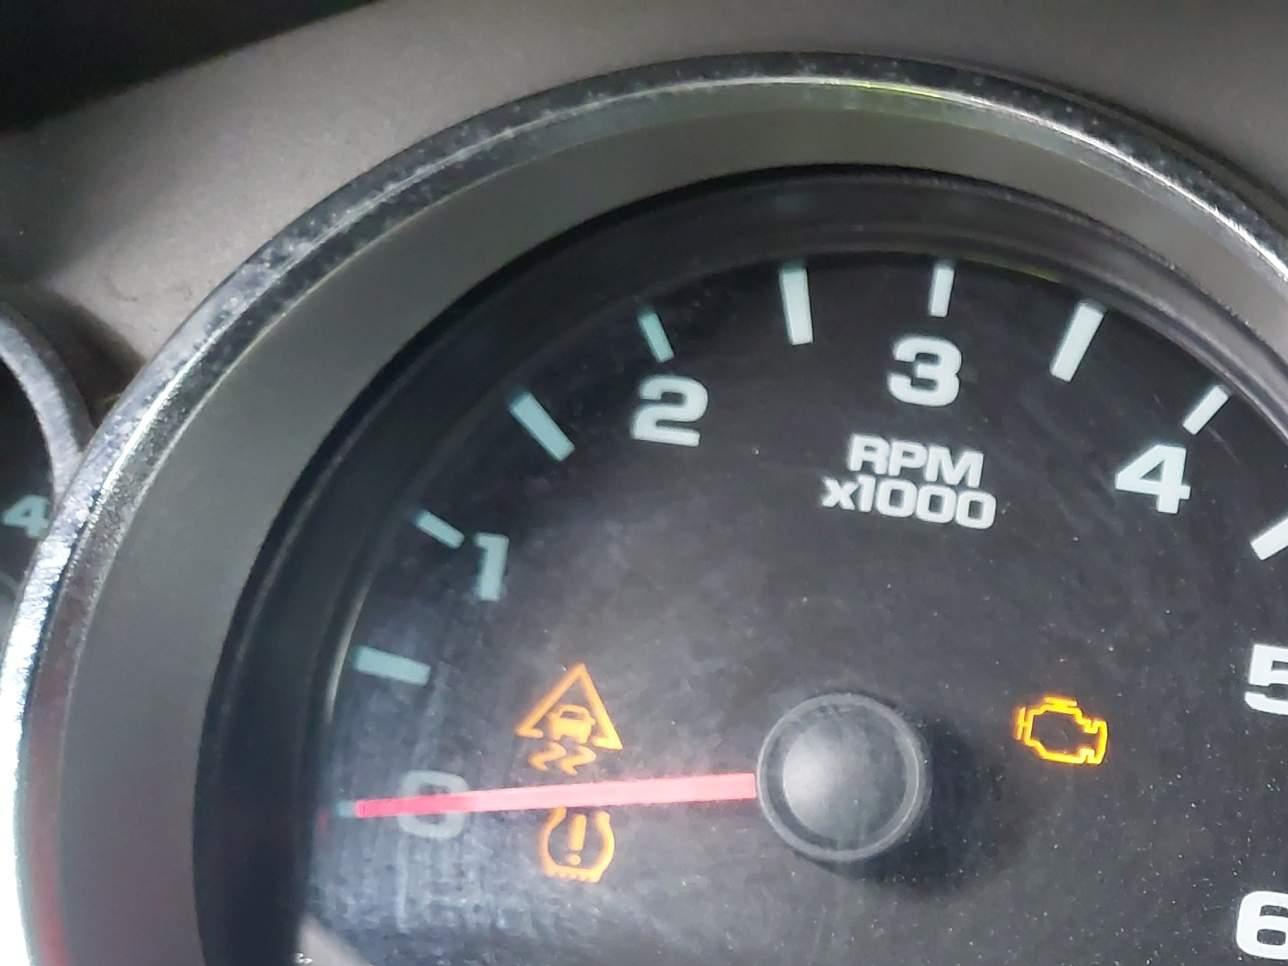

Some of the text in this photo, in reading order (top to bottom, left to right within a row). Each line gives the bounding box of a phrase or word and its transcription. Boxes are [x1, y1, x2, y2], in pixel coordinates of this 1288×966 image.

[888, 337, 961, 406] 3
[633, 378, 707, 446] 2
[848, 435, 983, 483] RPM
[1115, 444, 1190, 513] 4
[3, 494, 49, 539] 4
[822, 471, 996, 528] x1000
[477, 536, 505, 601] 1
[397, 770, 469, 838] 0
